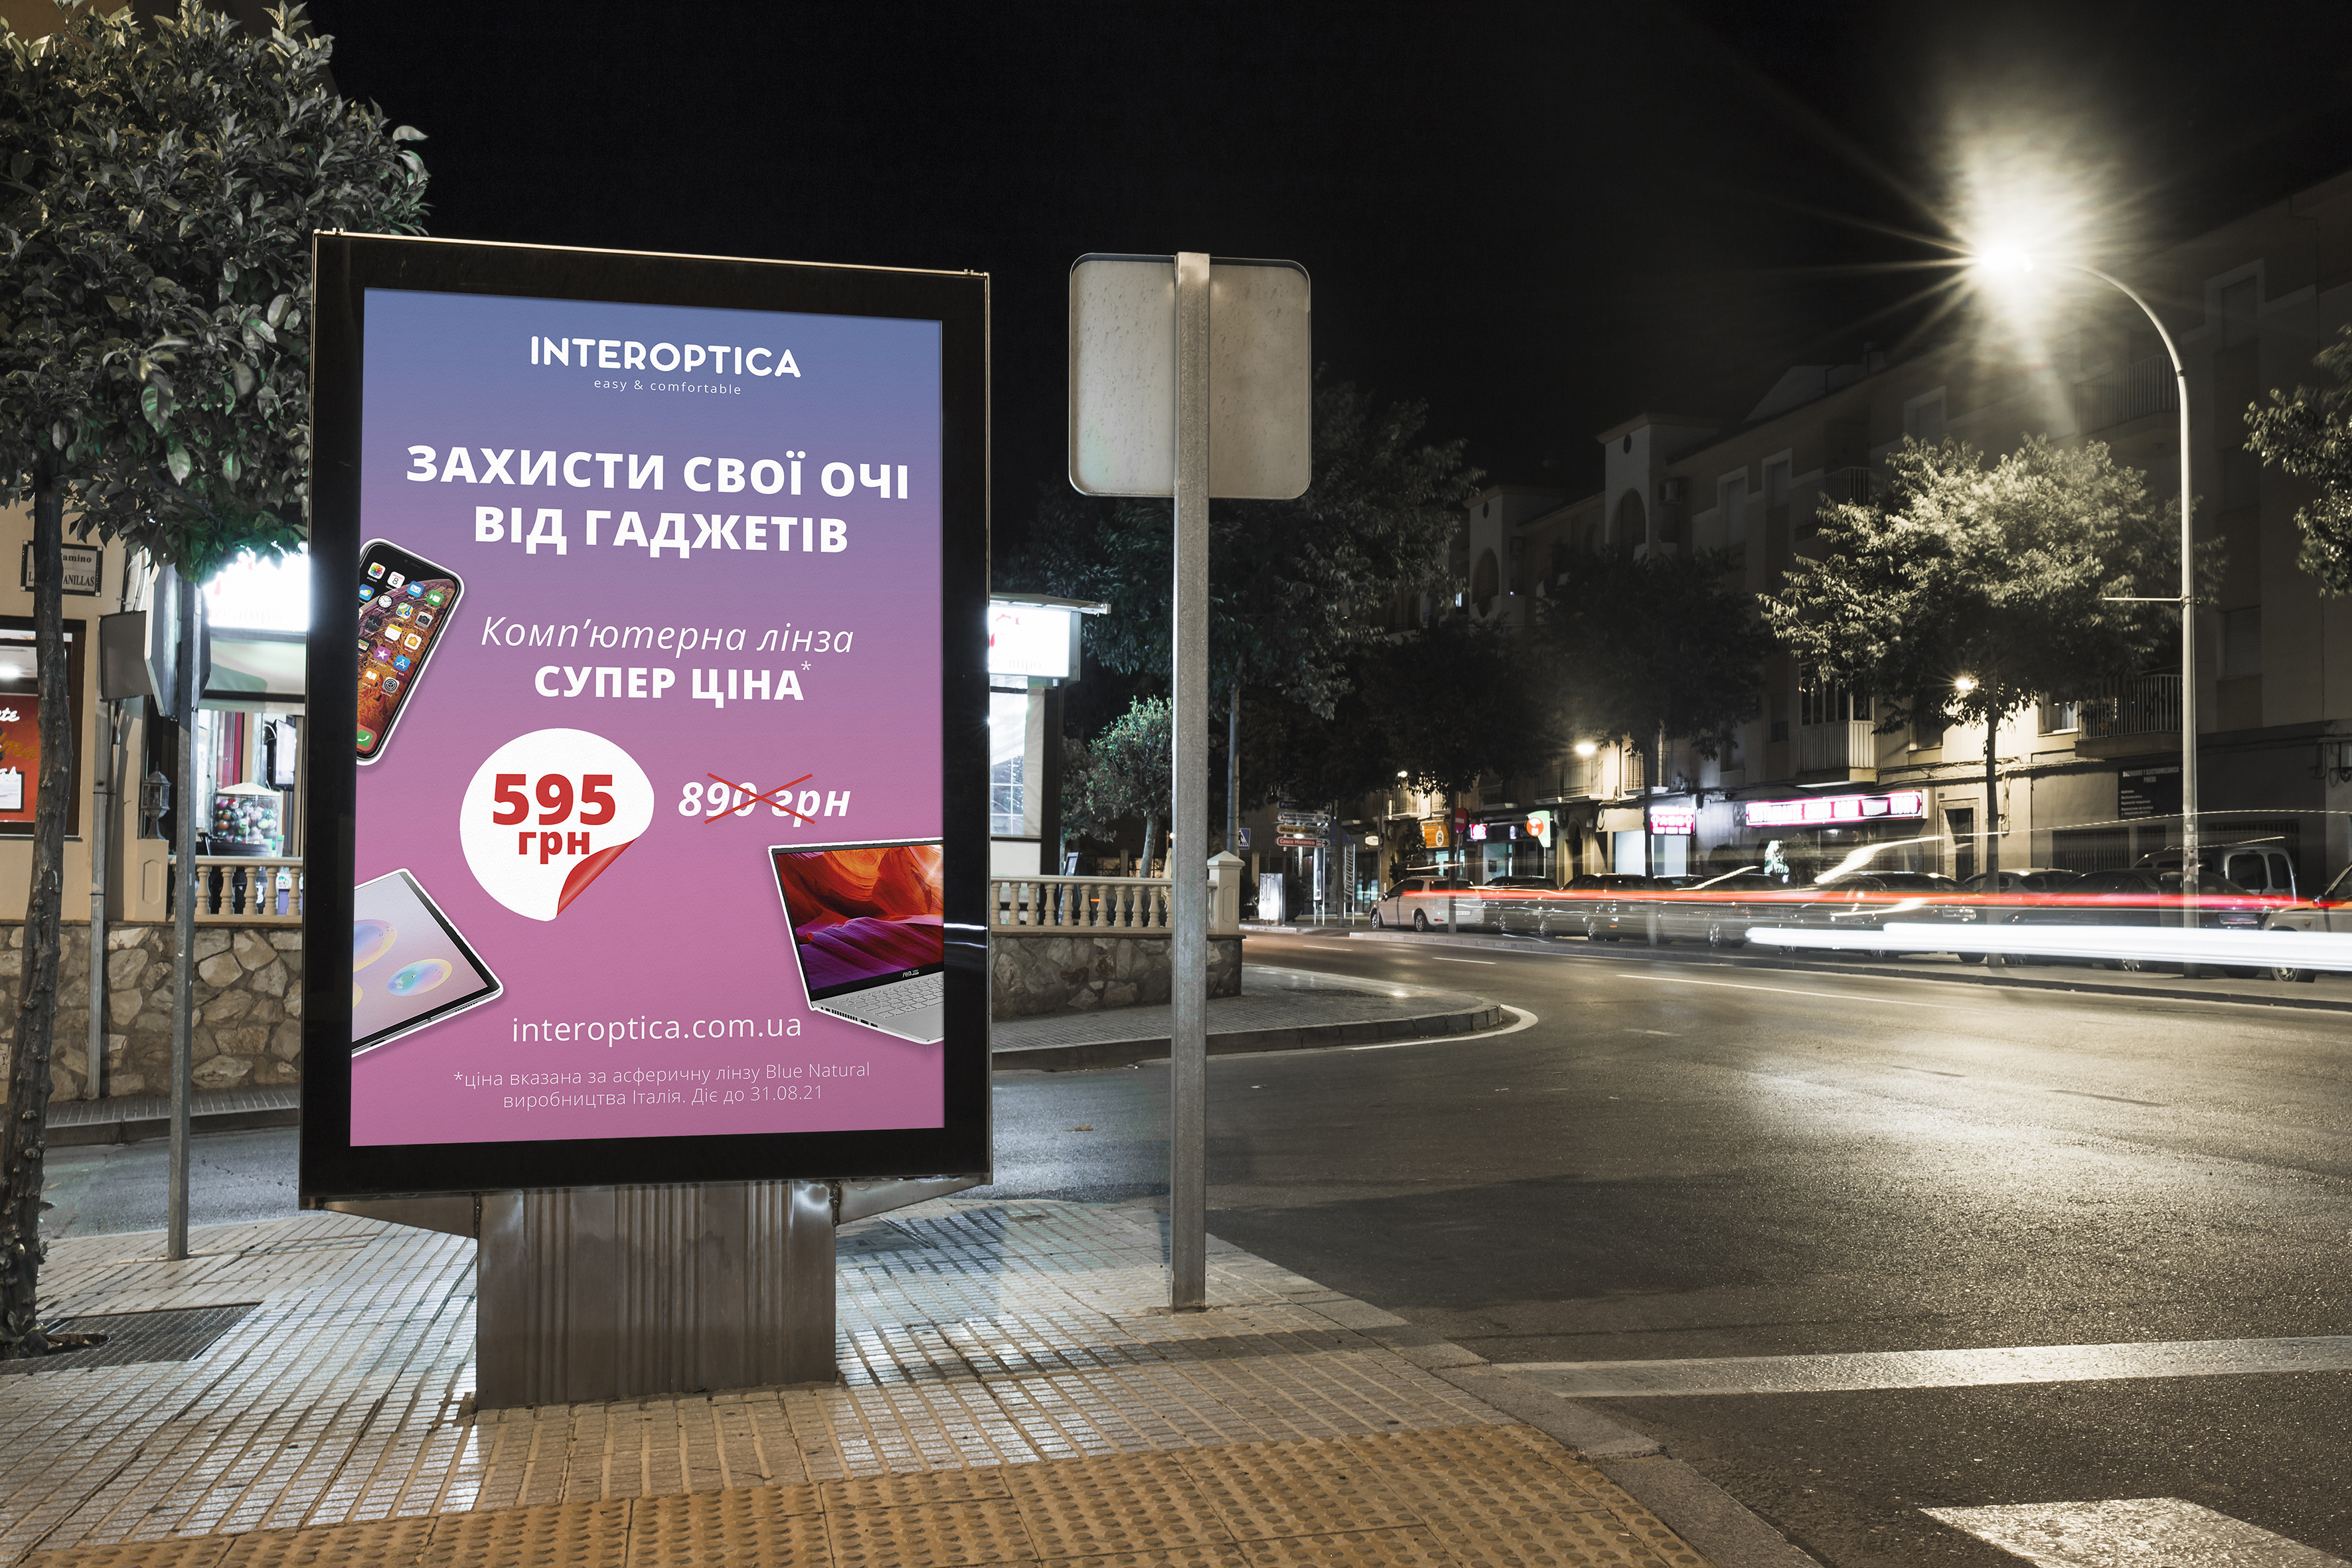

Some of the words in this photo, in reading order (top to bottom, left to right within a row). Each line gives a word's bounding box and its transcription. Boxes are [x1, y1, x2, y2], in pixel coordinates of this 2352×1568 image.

[531, 336, 801, 378] INTEROPTICA
[594, 380, 627, 392] easy
[634, 380, 643, 390] &
[651, 381, 742, 395] comfortable
[407, 445, 664, 490] ЗАХИСТИ
[684, 451, 806, 495] СВОЇ
[821, 462, 908, 499] ОЧІ
[475, 507, 567, 555] ВІД
[586, 510, 848, 558] ГАДЖЕТІВ
[61, 554, 92, 563] amino
[63, 574, 95, 586] ANILLAS
[756, 623, 854, 653] лінза
[535, 666, 676, 698] СУПЕР
[493, 774, 615, 825] 595
[678, 782, 757, 817] 890
[771, 790, 850, 827] грн
[518, 832, 589, 864] грн
[902, 969, 919, 978] ASUS
[514, 1016, 801, 1048] interoptica.com.ua
[510, 1071, 581, 1085] вказана
[588, 1071, 606, 1083] за
[613, 1067, 710, 1088] асферичну
[716, 1066, 759, 1083] лінзу
[767, 1063, 802, 1079] Blue
[810, 1062, 870, 1078] Natural
[504, 1091, 625, 1111] виробництва
[633, 1089, 685, 1105] Італія.
[692, 1086, 718, 1106] Діє
[724, 1090, 745, 1105] до
[751, 1084, 822, 1102] 31.08.21
